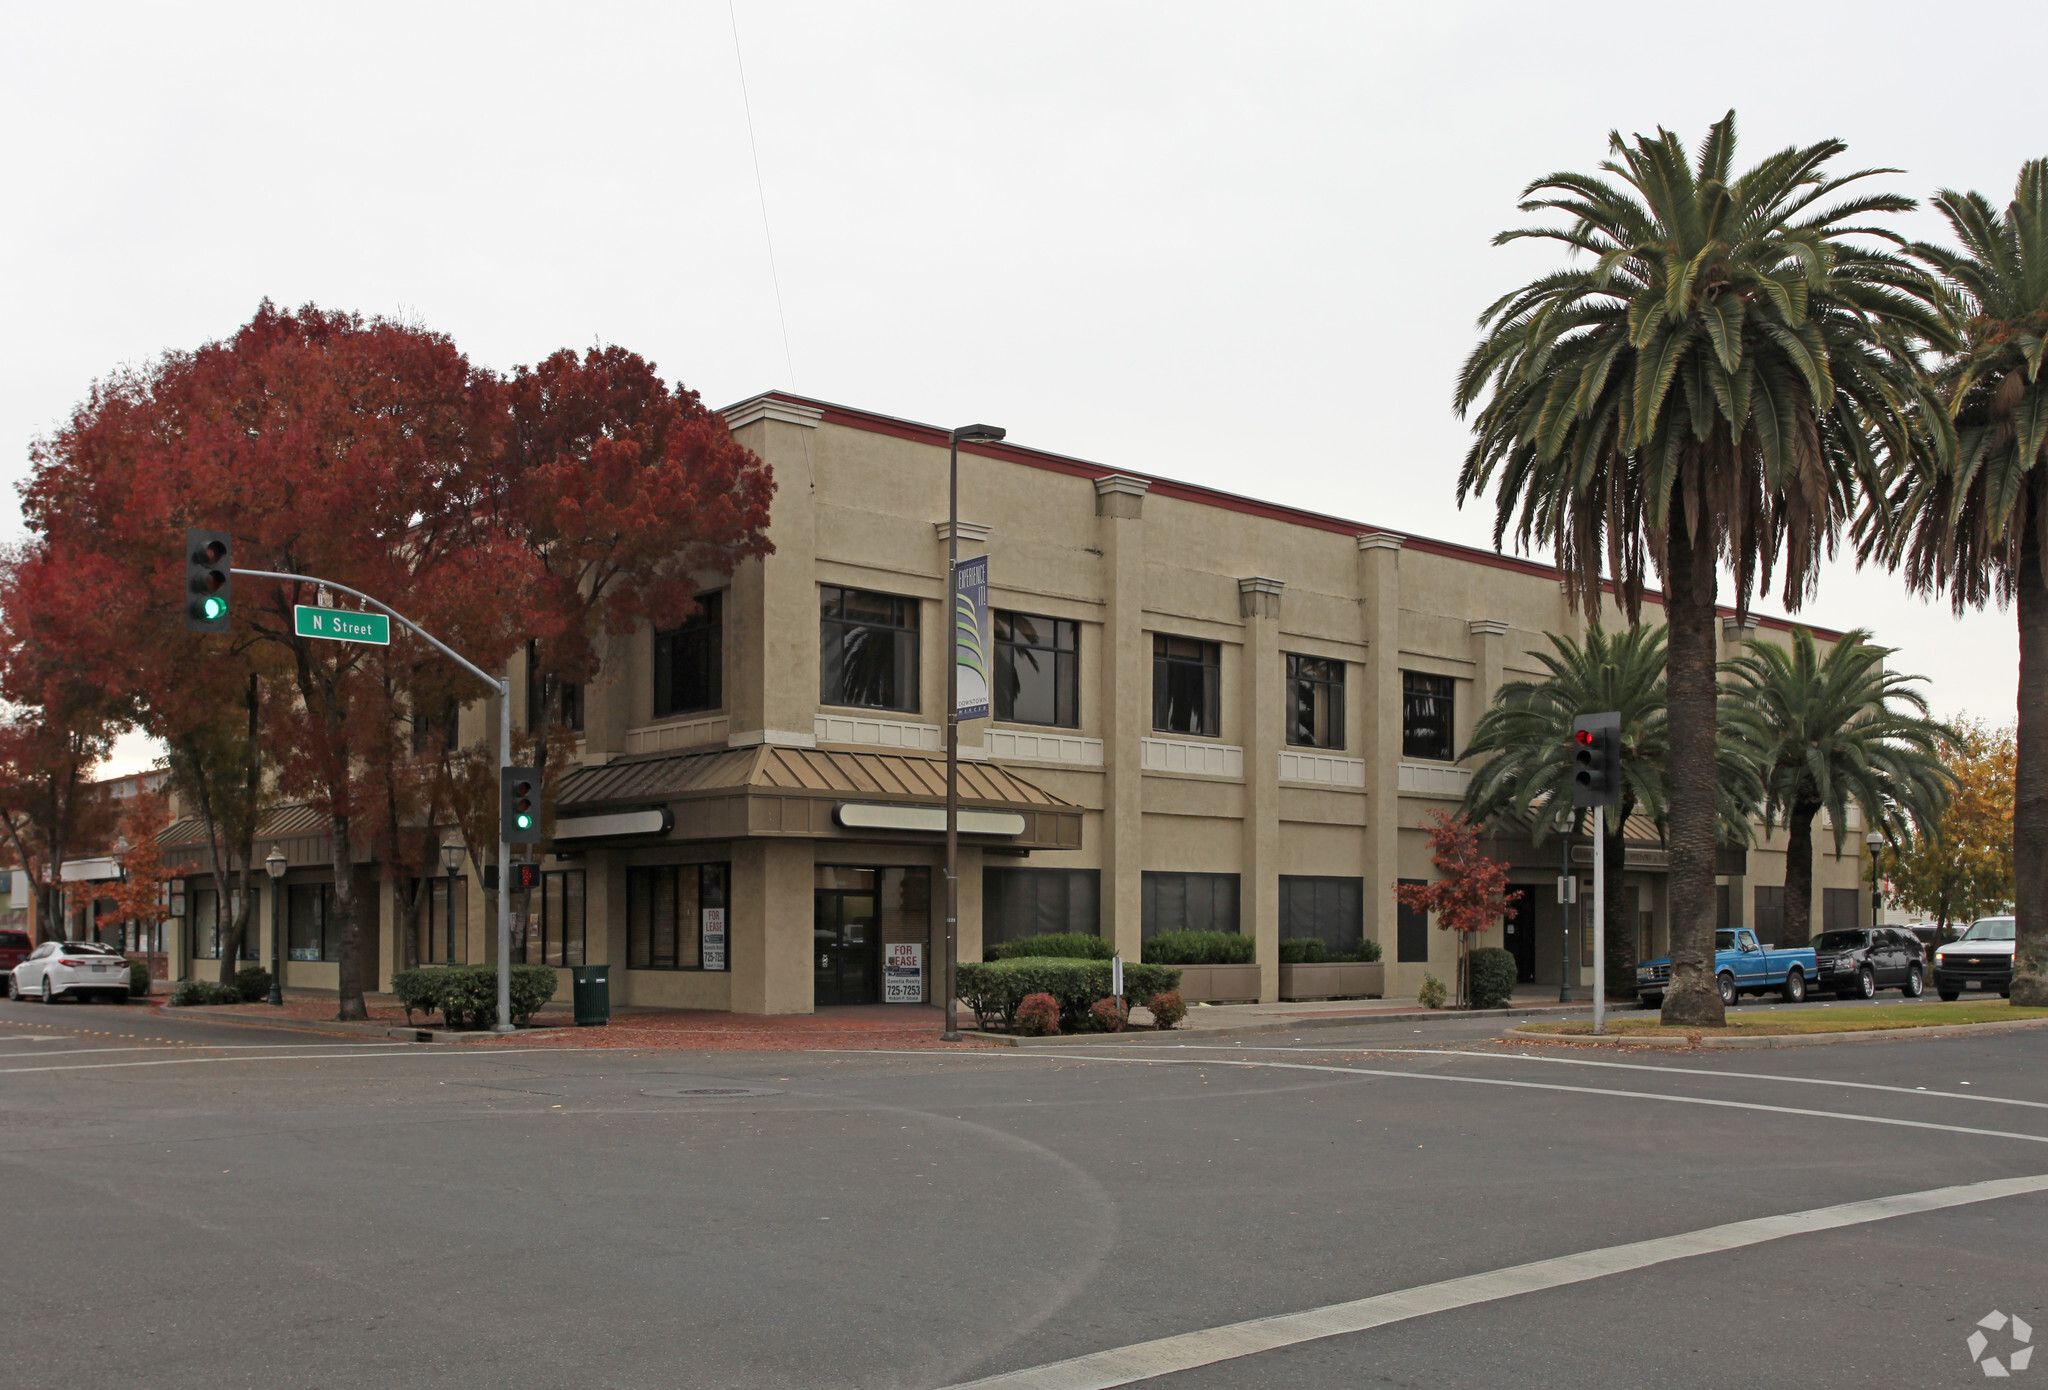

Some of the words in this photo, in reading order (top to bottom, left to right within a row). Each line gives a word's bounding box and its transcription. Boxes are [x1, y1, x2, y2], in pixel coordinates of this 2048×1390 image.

[958, 564, 986, 589] EXPERIENCE
[978, 585, 986, 607] IT!
[313, 615, 323, 630] N
[333, 617, 372, 635] Street
[958, 697, 987, 707] DOWNTOWN
[708, 910, 720, 920] FOR
[706, 922, 722, 932] LEASE
[894, 946, 912, 955] FOR
[887, 986, 920, 995] 725-7253
